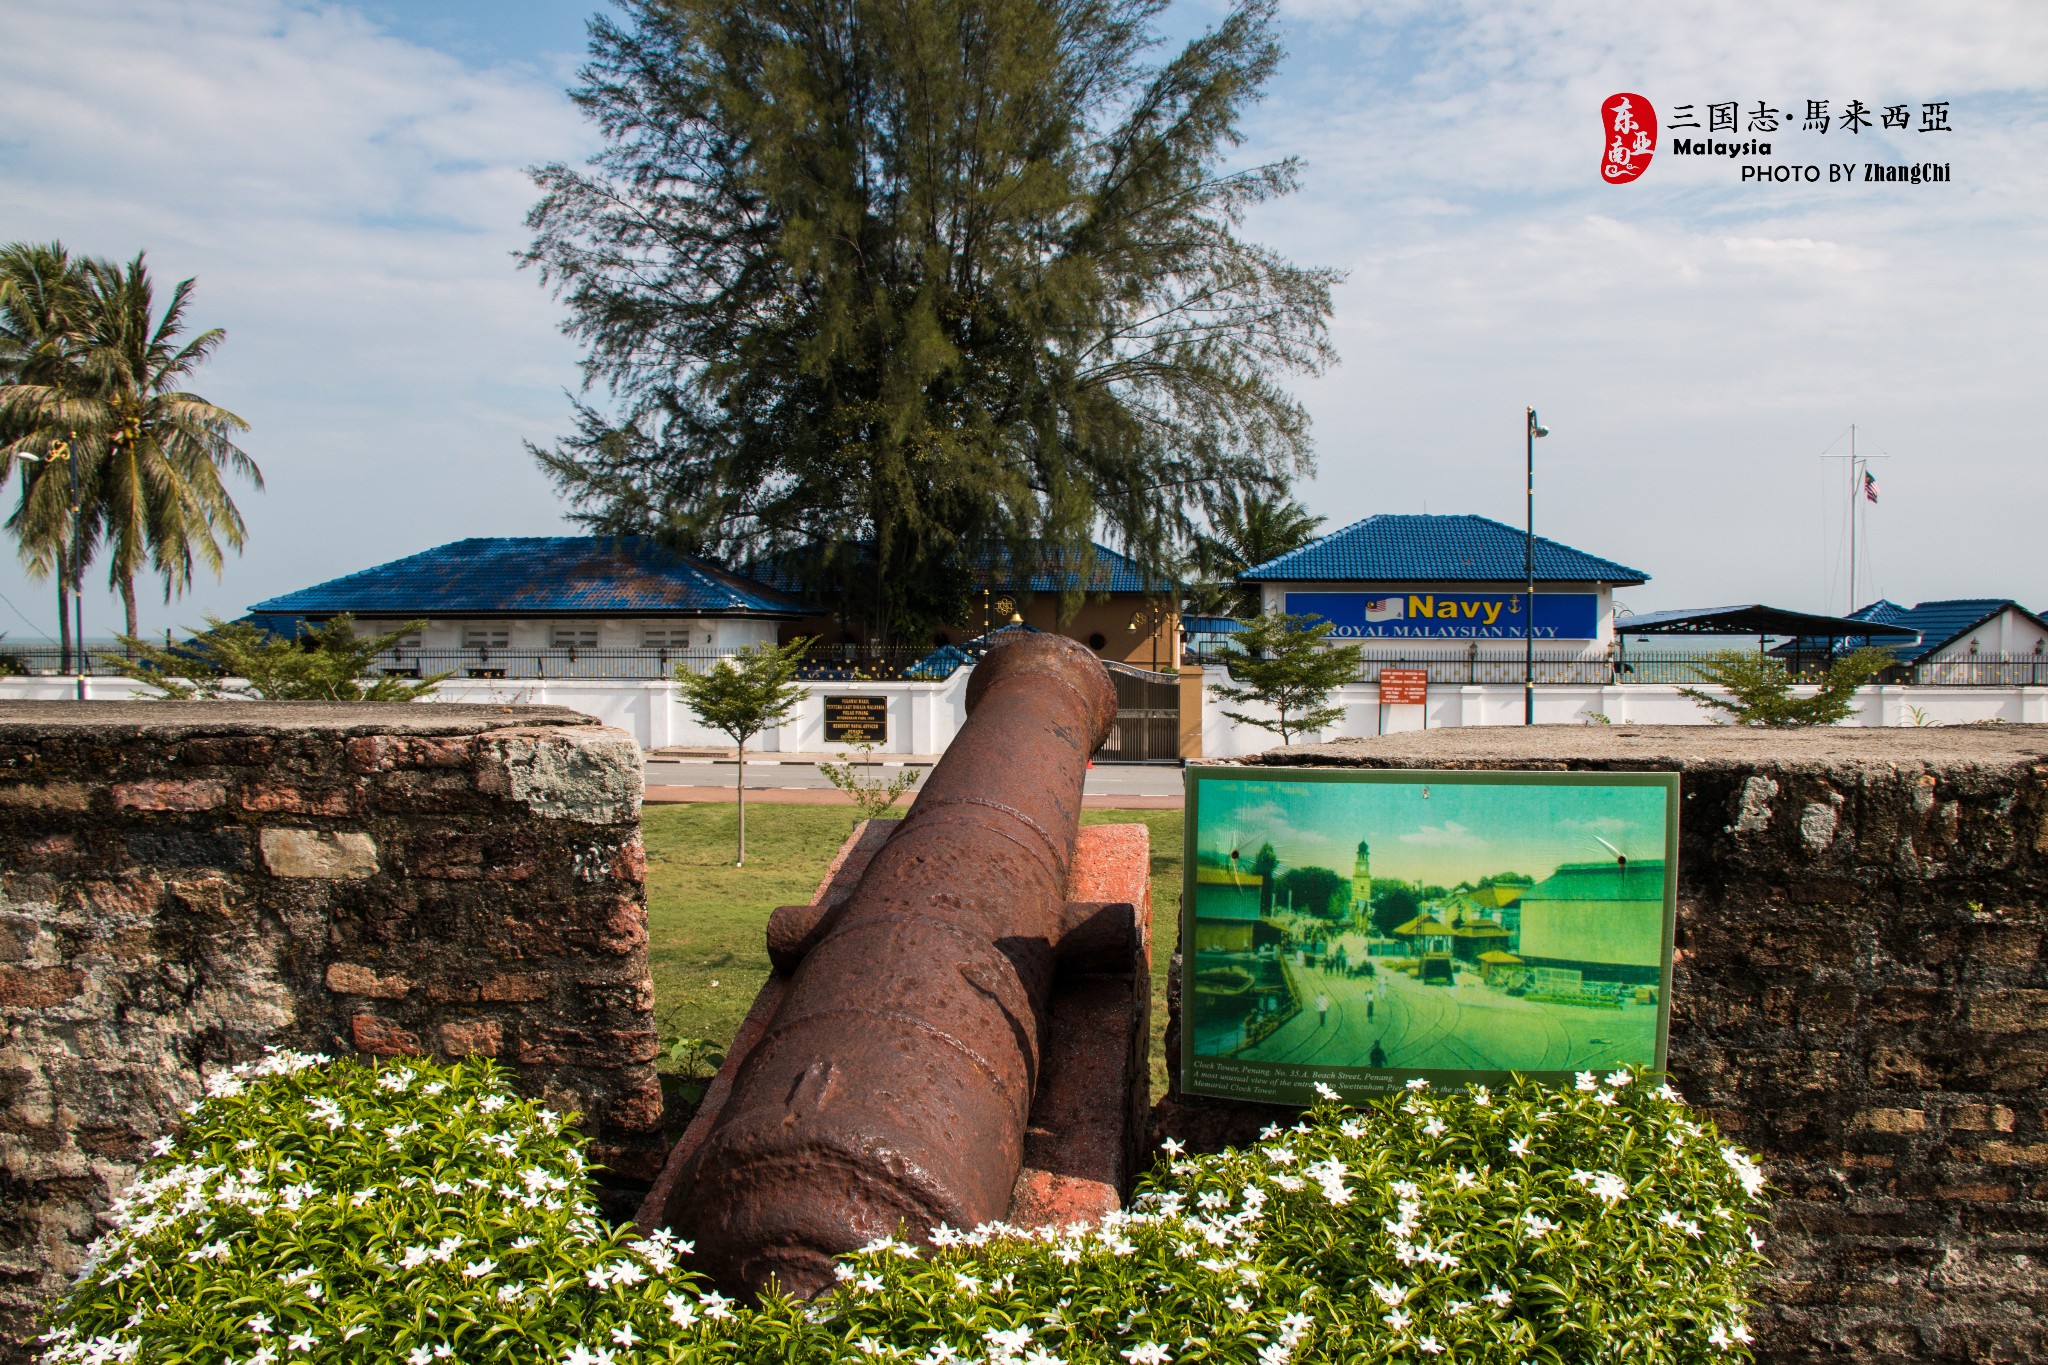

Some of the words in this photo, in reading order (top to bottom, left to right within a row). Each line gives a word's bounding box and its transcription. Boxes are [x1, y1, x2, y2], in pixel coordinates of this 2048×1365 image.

[1408, 595, 1503, 625] Navy
[1393, 626, 1504, 638] MALAYSIAN
[1193, 1060, 1215, 1070] Clock
[1312, 1071, 1336, 1080] Beach
[1193, 1079, 1229, 1090] Memorial
[1230, 1085, 1252, 1093] Clock
[1200, 1072, 1218, 1080] most
[1219, 1073, 1250, 1083] unusual
[1251, 1077, 1268, 1085] view
[1269, 1078, 1280, 1087] of
[1279, 1079, 1292, 1087] the
[1328, 1081, 1337, 1089] to
[1338, 1083, 1385, 1091] Swettenham
[1440, 1085, 1453, 1093] the
